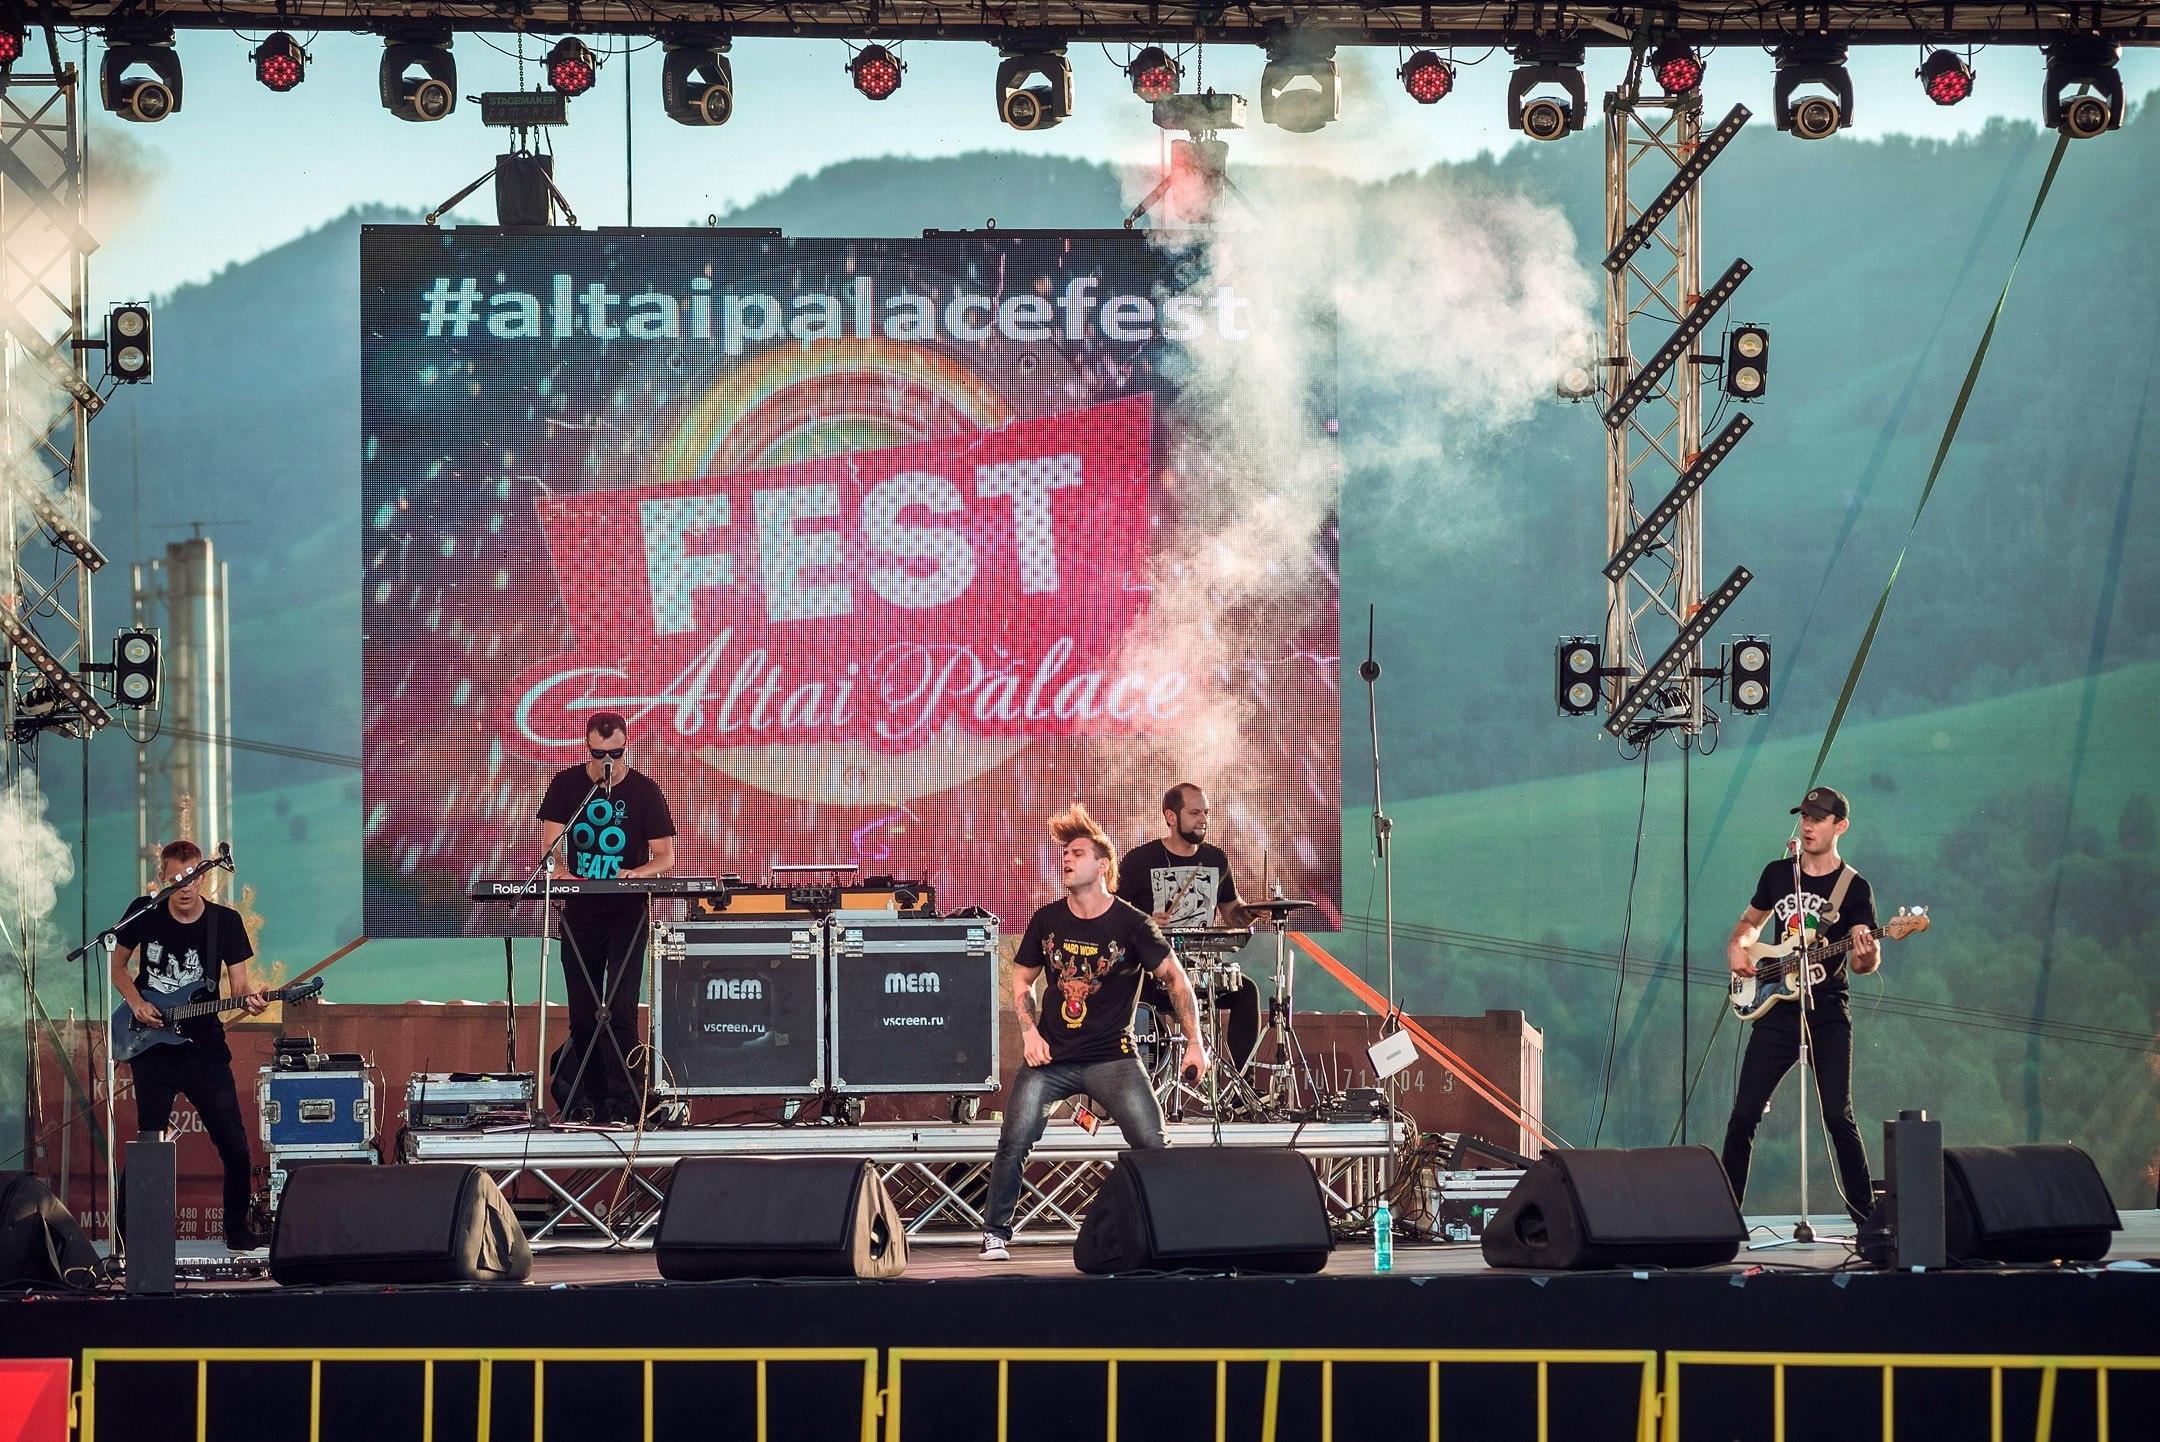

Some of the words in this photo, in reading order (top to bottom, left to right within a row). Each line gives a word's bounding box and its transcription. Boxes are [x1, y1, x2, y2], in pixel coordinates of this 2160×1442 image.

[489, 96, 556, 105] STAGEMAKER
[489, 107, 558, 117] COMPACT
[420, 274, 1250, 356] #altaipalacefest
[638, 453, 1083, 634] FEST
[514, 627, 862, 746] Altai
[1062, 942, 1079, 955] HARD
[1080, 945, 1099, 957] WORK
[882, 1015, 944, 1026] vscreen.ru
[703, 1022, 766, 1033] vscreen.ru
[1133, 1031, 1156, 1043] and
[205, 1207, 224, 1220] KGS
[204, 1221, 224, 1233] LBS
